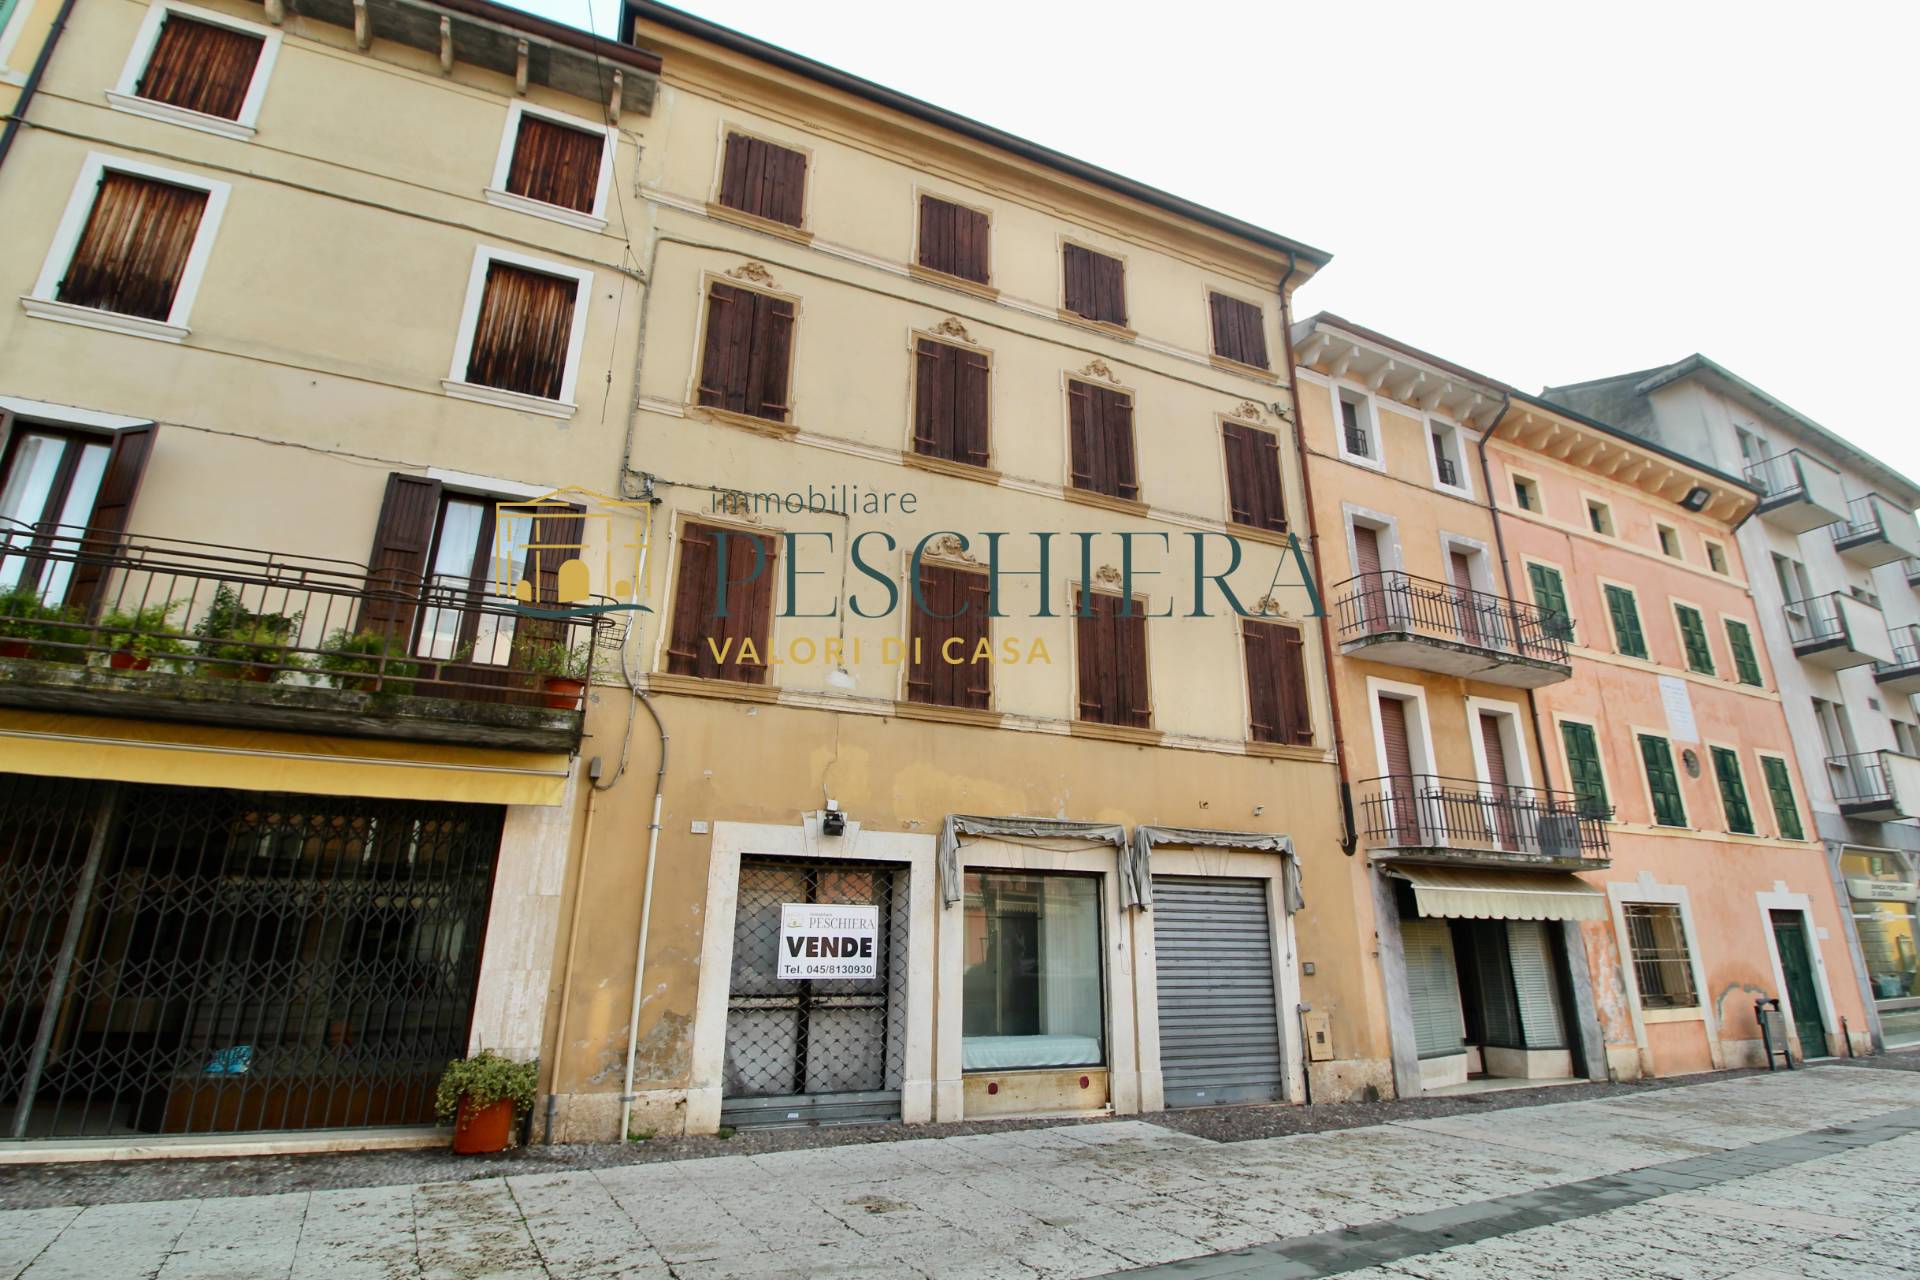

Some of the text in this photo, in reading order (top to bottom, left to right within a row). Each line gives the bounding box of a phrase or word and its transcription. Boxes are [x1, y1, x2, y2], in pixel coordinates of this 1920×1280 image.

[809, 917, 875, 929] PESCHIERA
[786, 936, 872, 957] VENDE
[784, 965, 872, 974] Tel. 045/8130930
